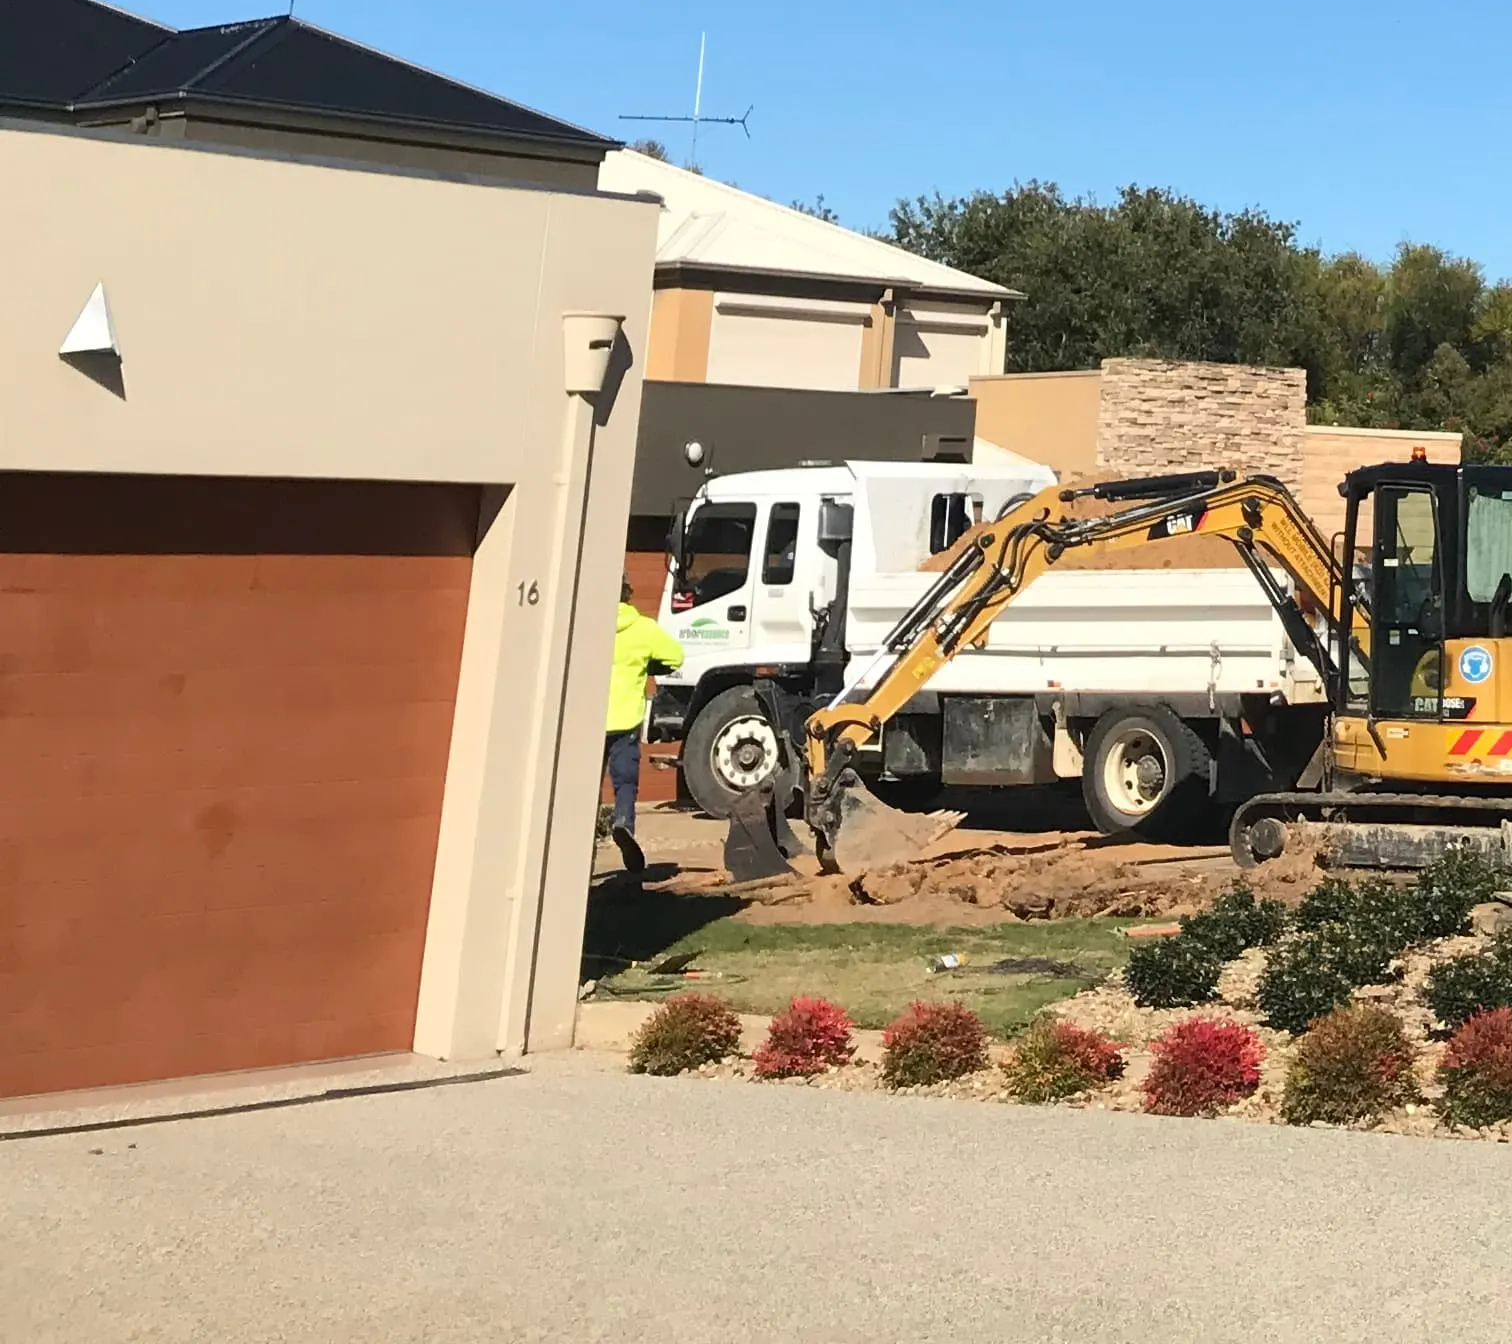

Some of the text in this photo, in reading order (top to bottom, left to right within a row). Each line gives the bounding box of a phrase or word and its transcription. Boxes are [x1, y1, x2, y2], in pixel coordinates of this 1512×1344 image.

[1166, 513, 1193, 535] CAT
[518, 579, 540, 607] 16
[1414, 697, 1438, 712] CAT
